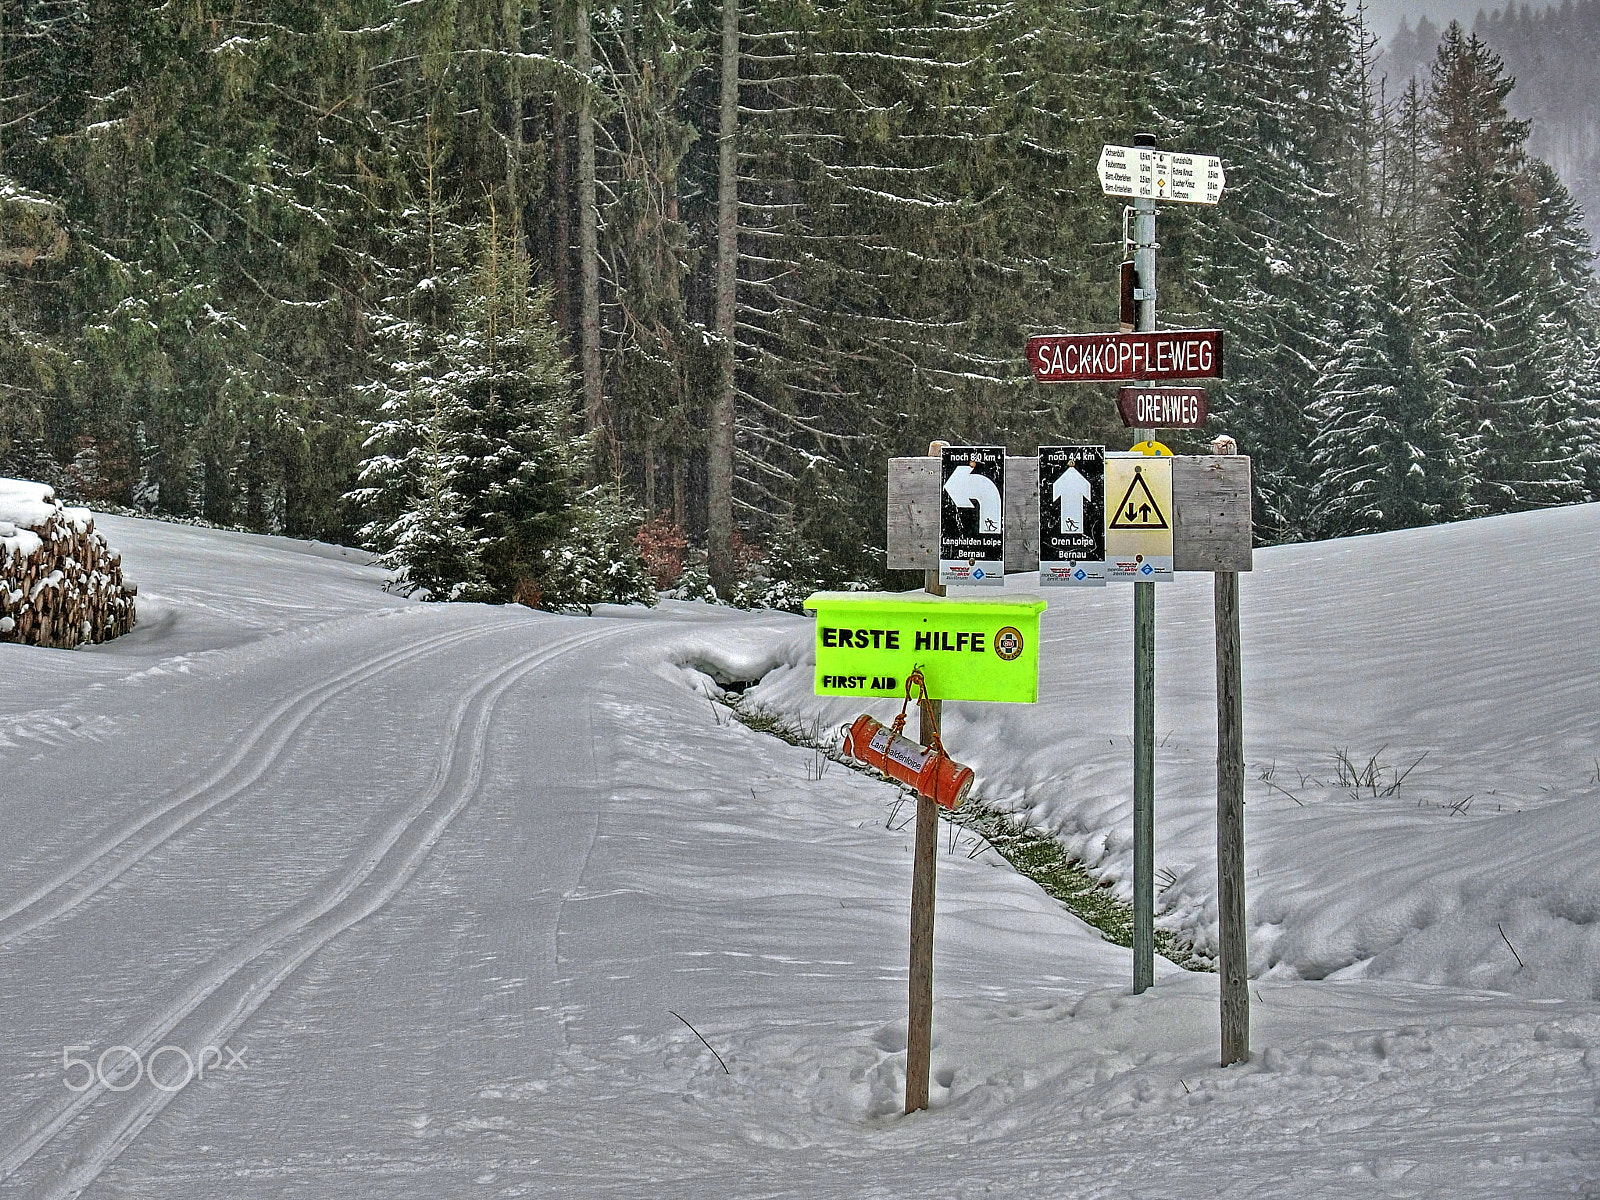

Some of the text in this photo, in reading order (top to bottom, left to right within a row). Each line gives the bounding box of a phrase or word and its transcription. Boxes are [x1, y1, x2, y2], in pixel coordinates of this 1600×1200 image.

[1038, 337, 1212, 374] SACKKÖPFLEWEG
[1136, 394, 1199, 424] ORENWEG
[950, 452, 969, 462] noch
[983, 452, 996, 462] km
[1048, 452, 1066, 462] noch
[1082, 452, 1096, 462] km
[942, 537, 1002, 548] Langhalden Loipe
[1051, 537, 1094, 548] Oren Loipe
[958, 550, 986, 559] Bernau
[1058, 550, 1087, 559] Bernau
[822, 627, 986, 653] ERSTE HILFE
[823, 675, 897, 690] FIRST AID
